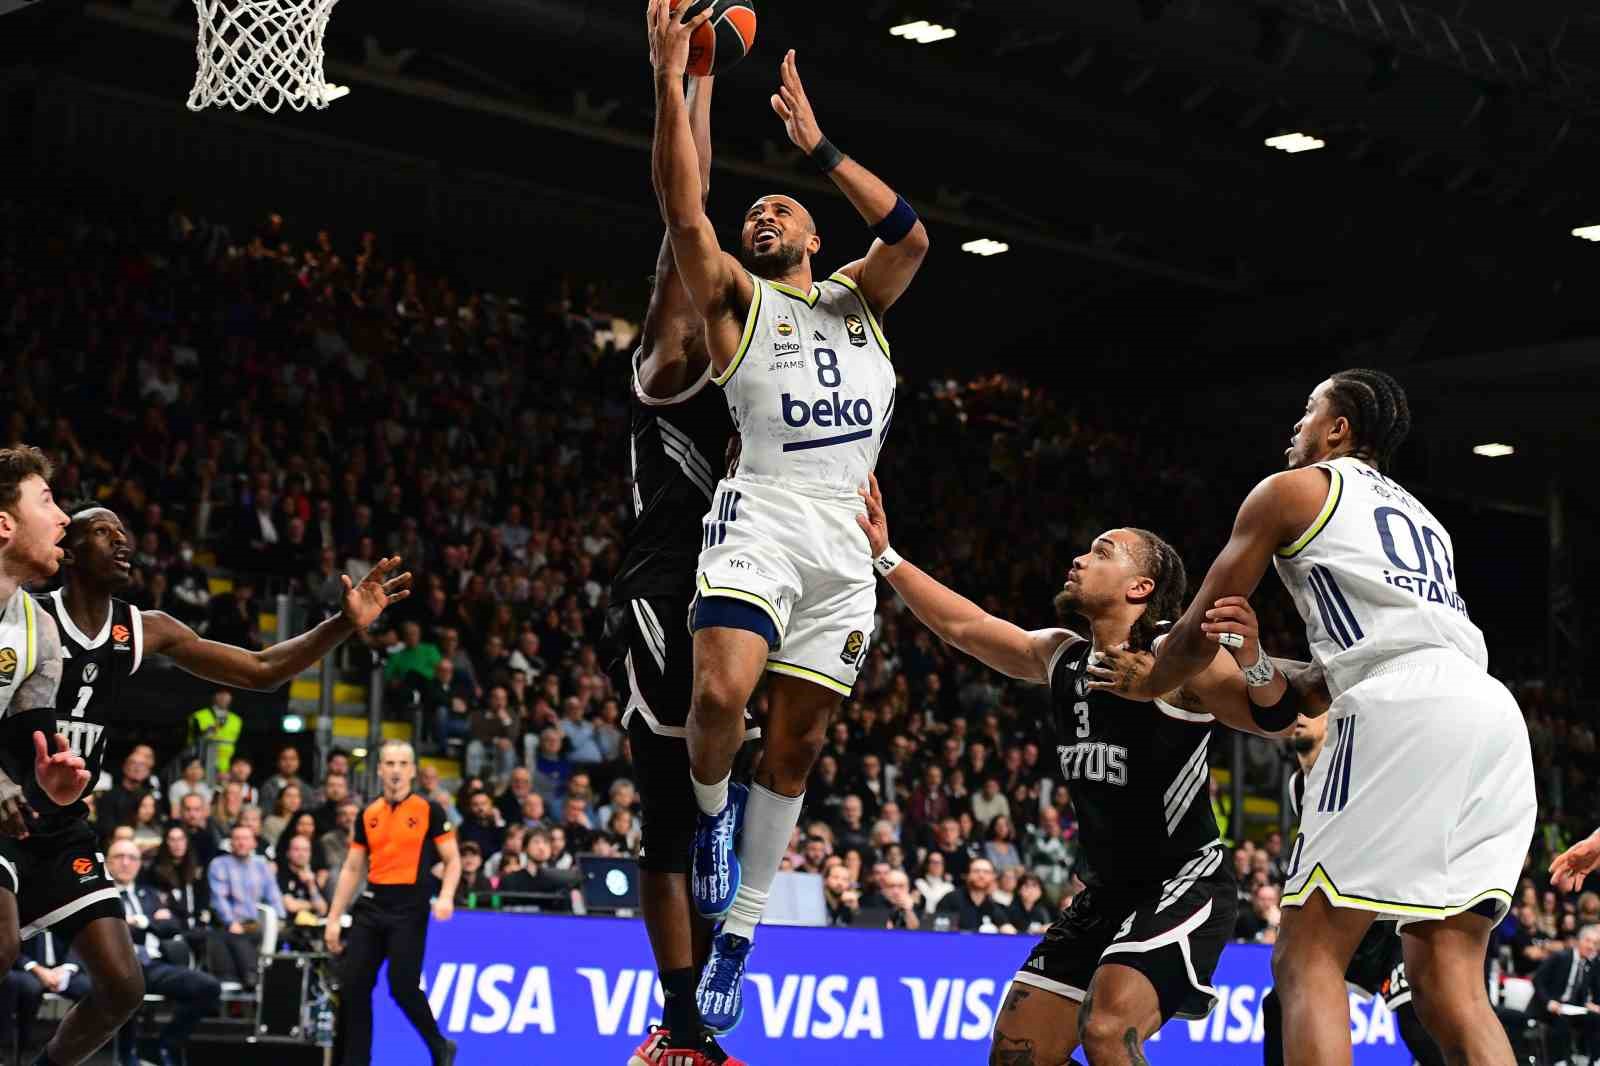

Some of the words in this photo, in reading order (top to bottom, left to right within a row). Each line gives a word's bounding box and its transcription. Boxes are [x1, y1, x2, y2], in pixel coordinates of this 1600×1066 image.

[774, 342, 800, 351] beko
[814, 348, 842, 388] 8
[781, 391, 873, 427] beko
[71, 686, 94, 718] 1
[1073, 701, 1090, 738] 3
[746, 973, 884, 1039] VISA
